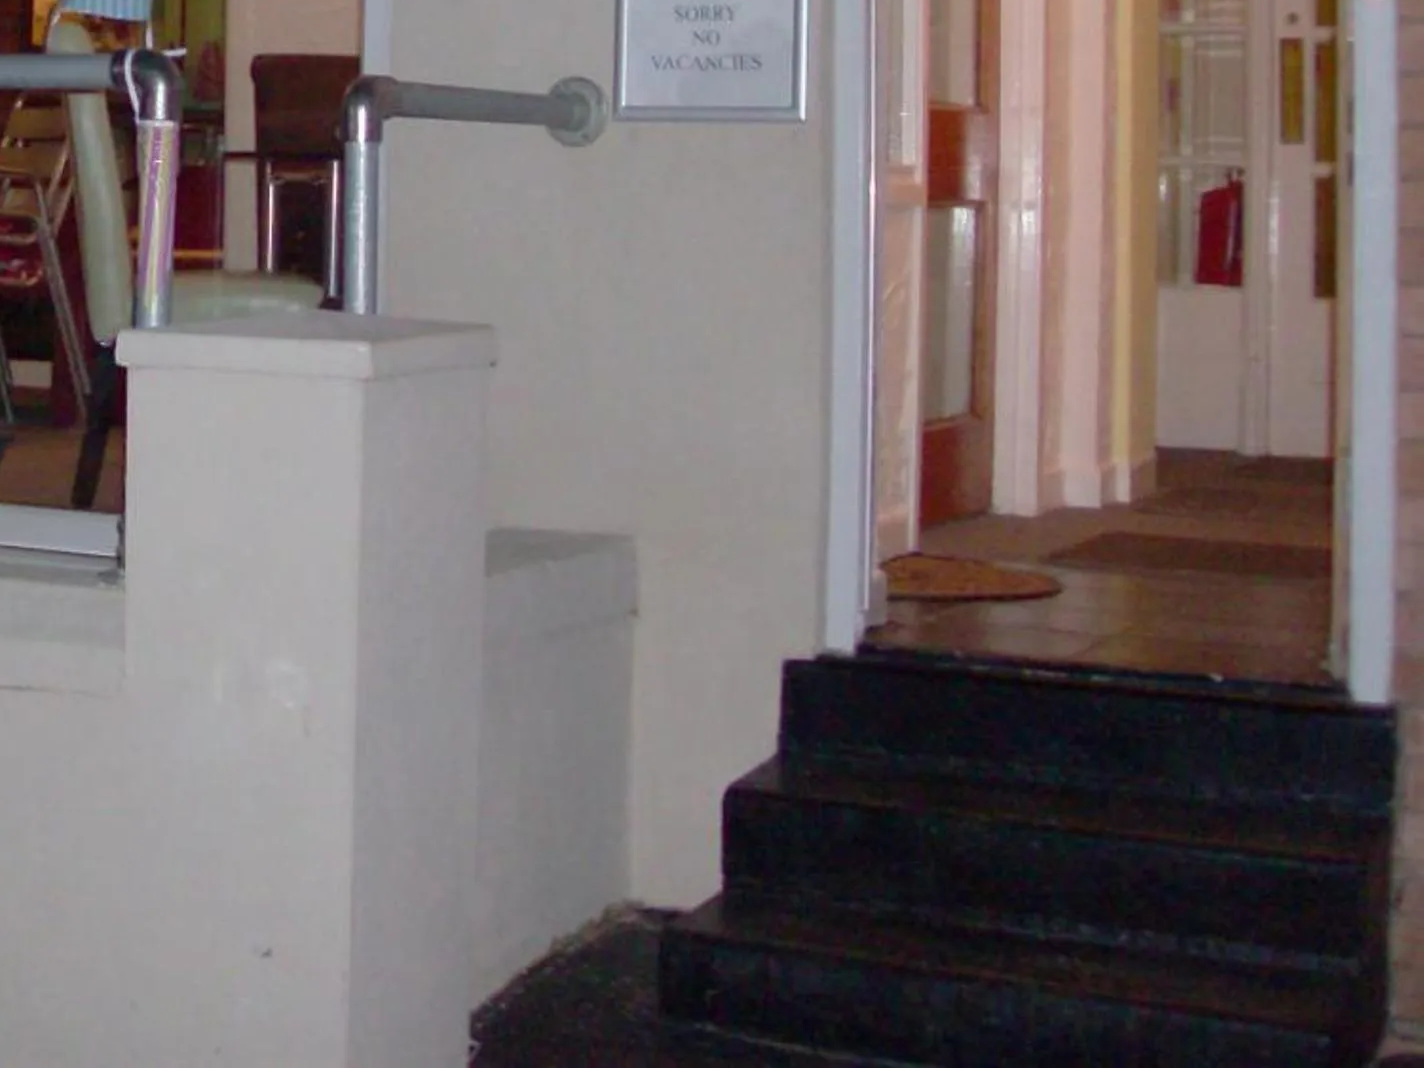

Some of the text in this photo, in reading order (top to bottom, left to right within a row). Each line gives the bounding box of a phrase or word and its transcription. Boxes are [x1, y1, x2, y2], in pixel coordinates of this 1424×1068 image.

[673, 4, 736, 23] SORRY
[692, 30, 721, 46] NO
[650, 54, 763, 71] VACANCIES
